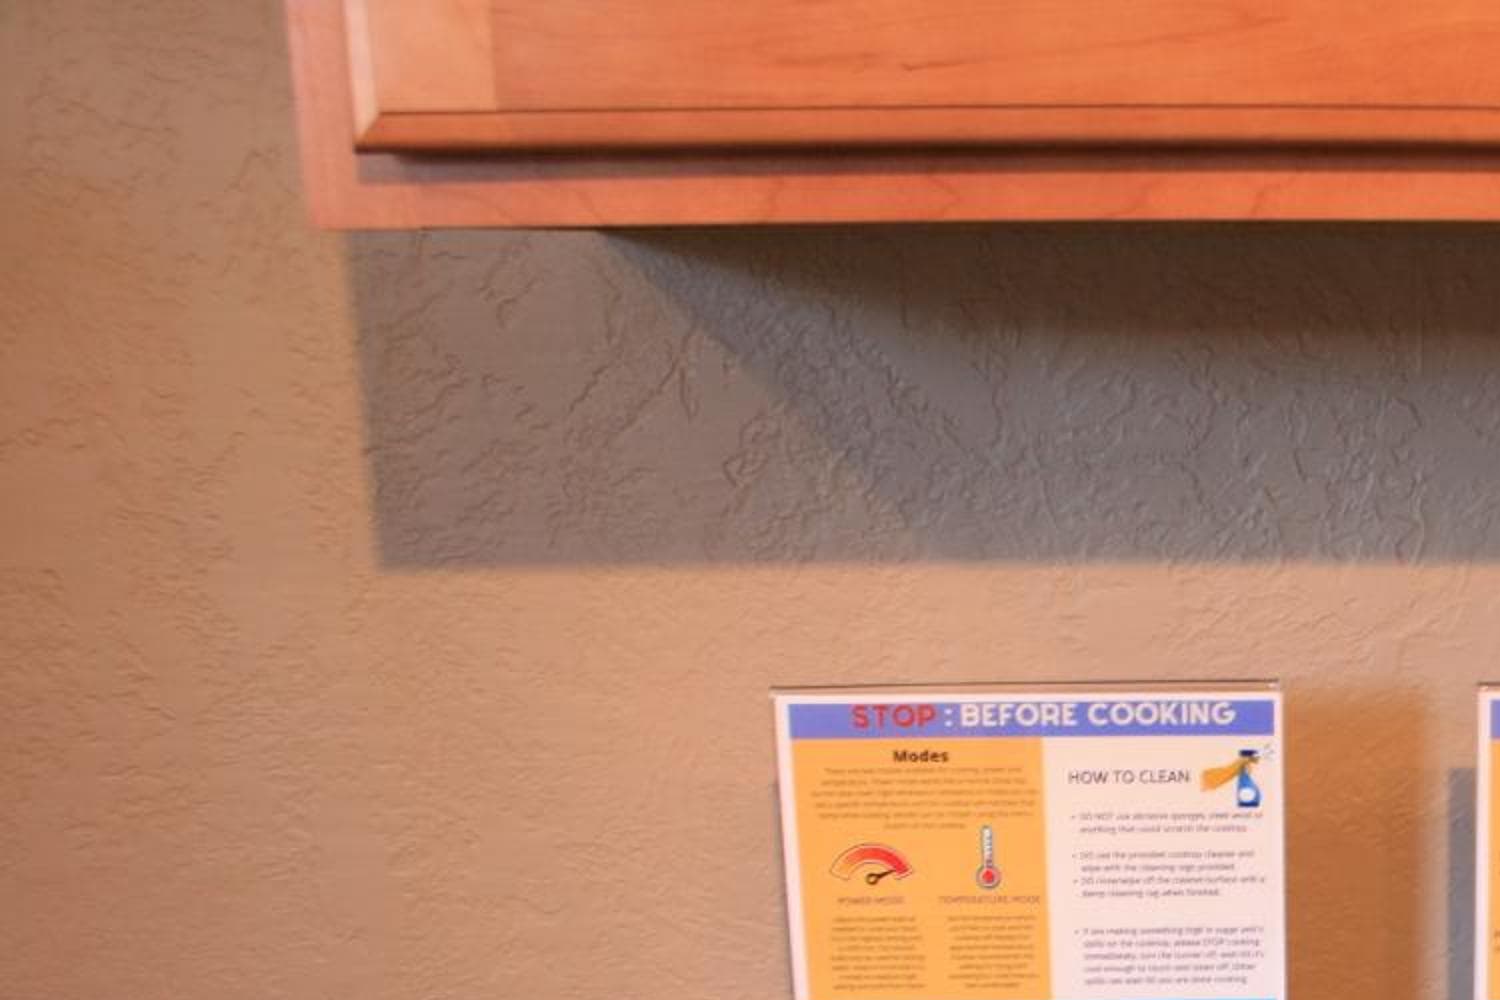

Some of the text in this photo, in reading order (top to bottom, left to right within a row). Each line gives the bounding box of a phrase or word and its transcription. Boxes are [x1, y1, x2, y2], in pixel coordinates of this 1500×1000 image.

[851, 704, 936, 729] STOP
[960, 702, 1077, 728] BEFORE
[1087, 701, 1238, 727] COOKING
[892, 749, 950, 763] Modes
[1068, 770, 1190, 784] HOW TO CLEAN
